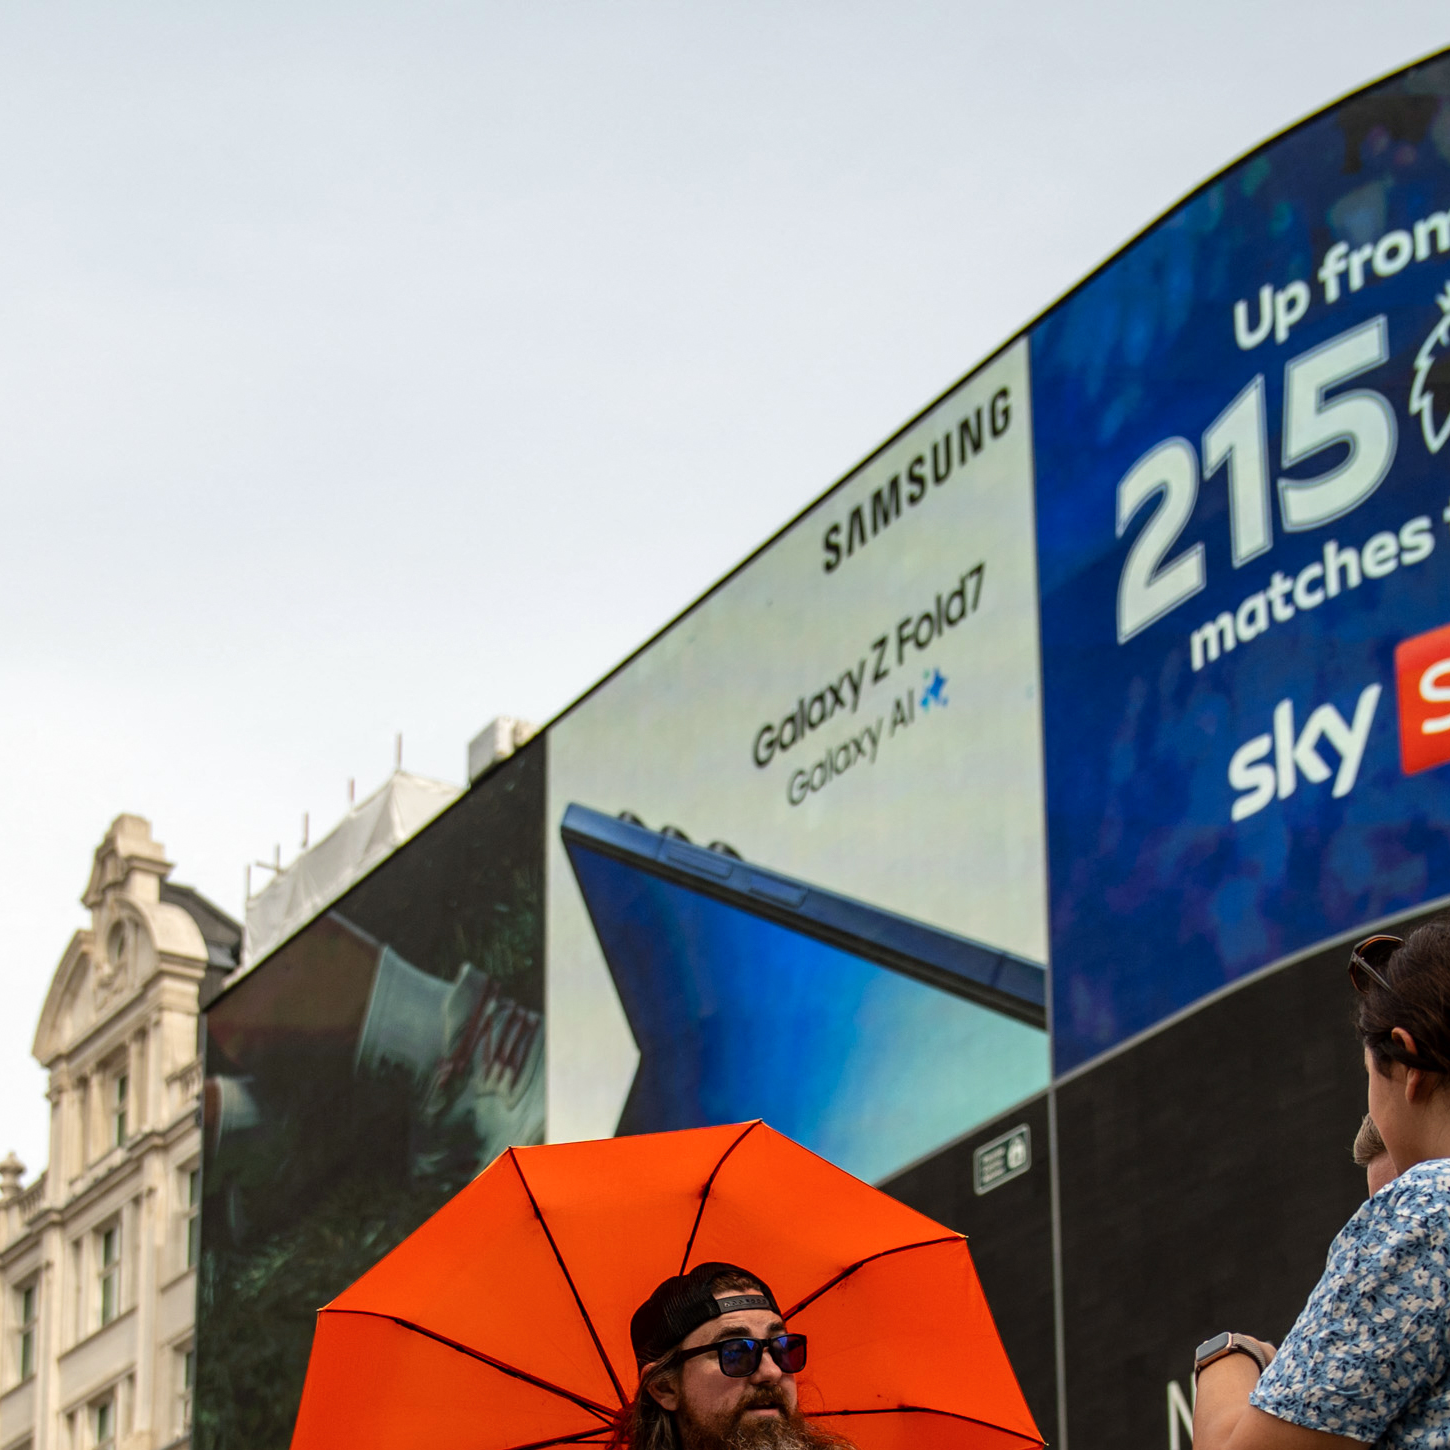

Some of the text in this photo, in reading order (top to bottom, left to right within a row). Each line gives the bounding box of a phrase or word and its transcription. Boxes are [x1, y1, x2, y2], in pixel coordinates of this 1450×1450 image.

[1233, 283, 1309, 350] Up
[822, 385, 1012, 574] SAMSUNG
[1114, 313, 1399, 646] 215
[753, 560, 987, 769] Galaxy Z Fold7
[1189, 514, 1436, 672] matches
[787, 716, 884, 806] Galaxy
[1228, 682, 1382, 822] sky
